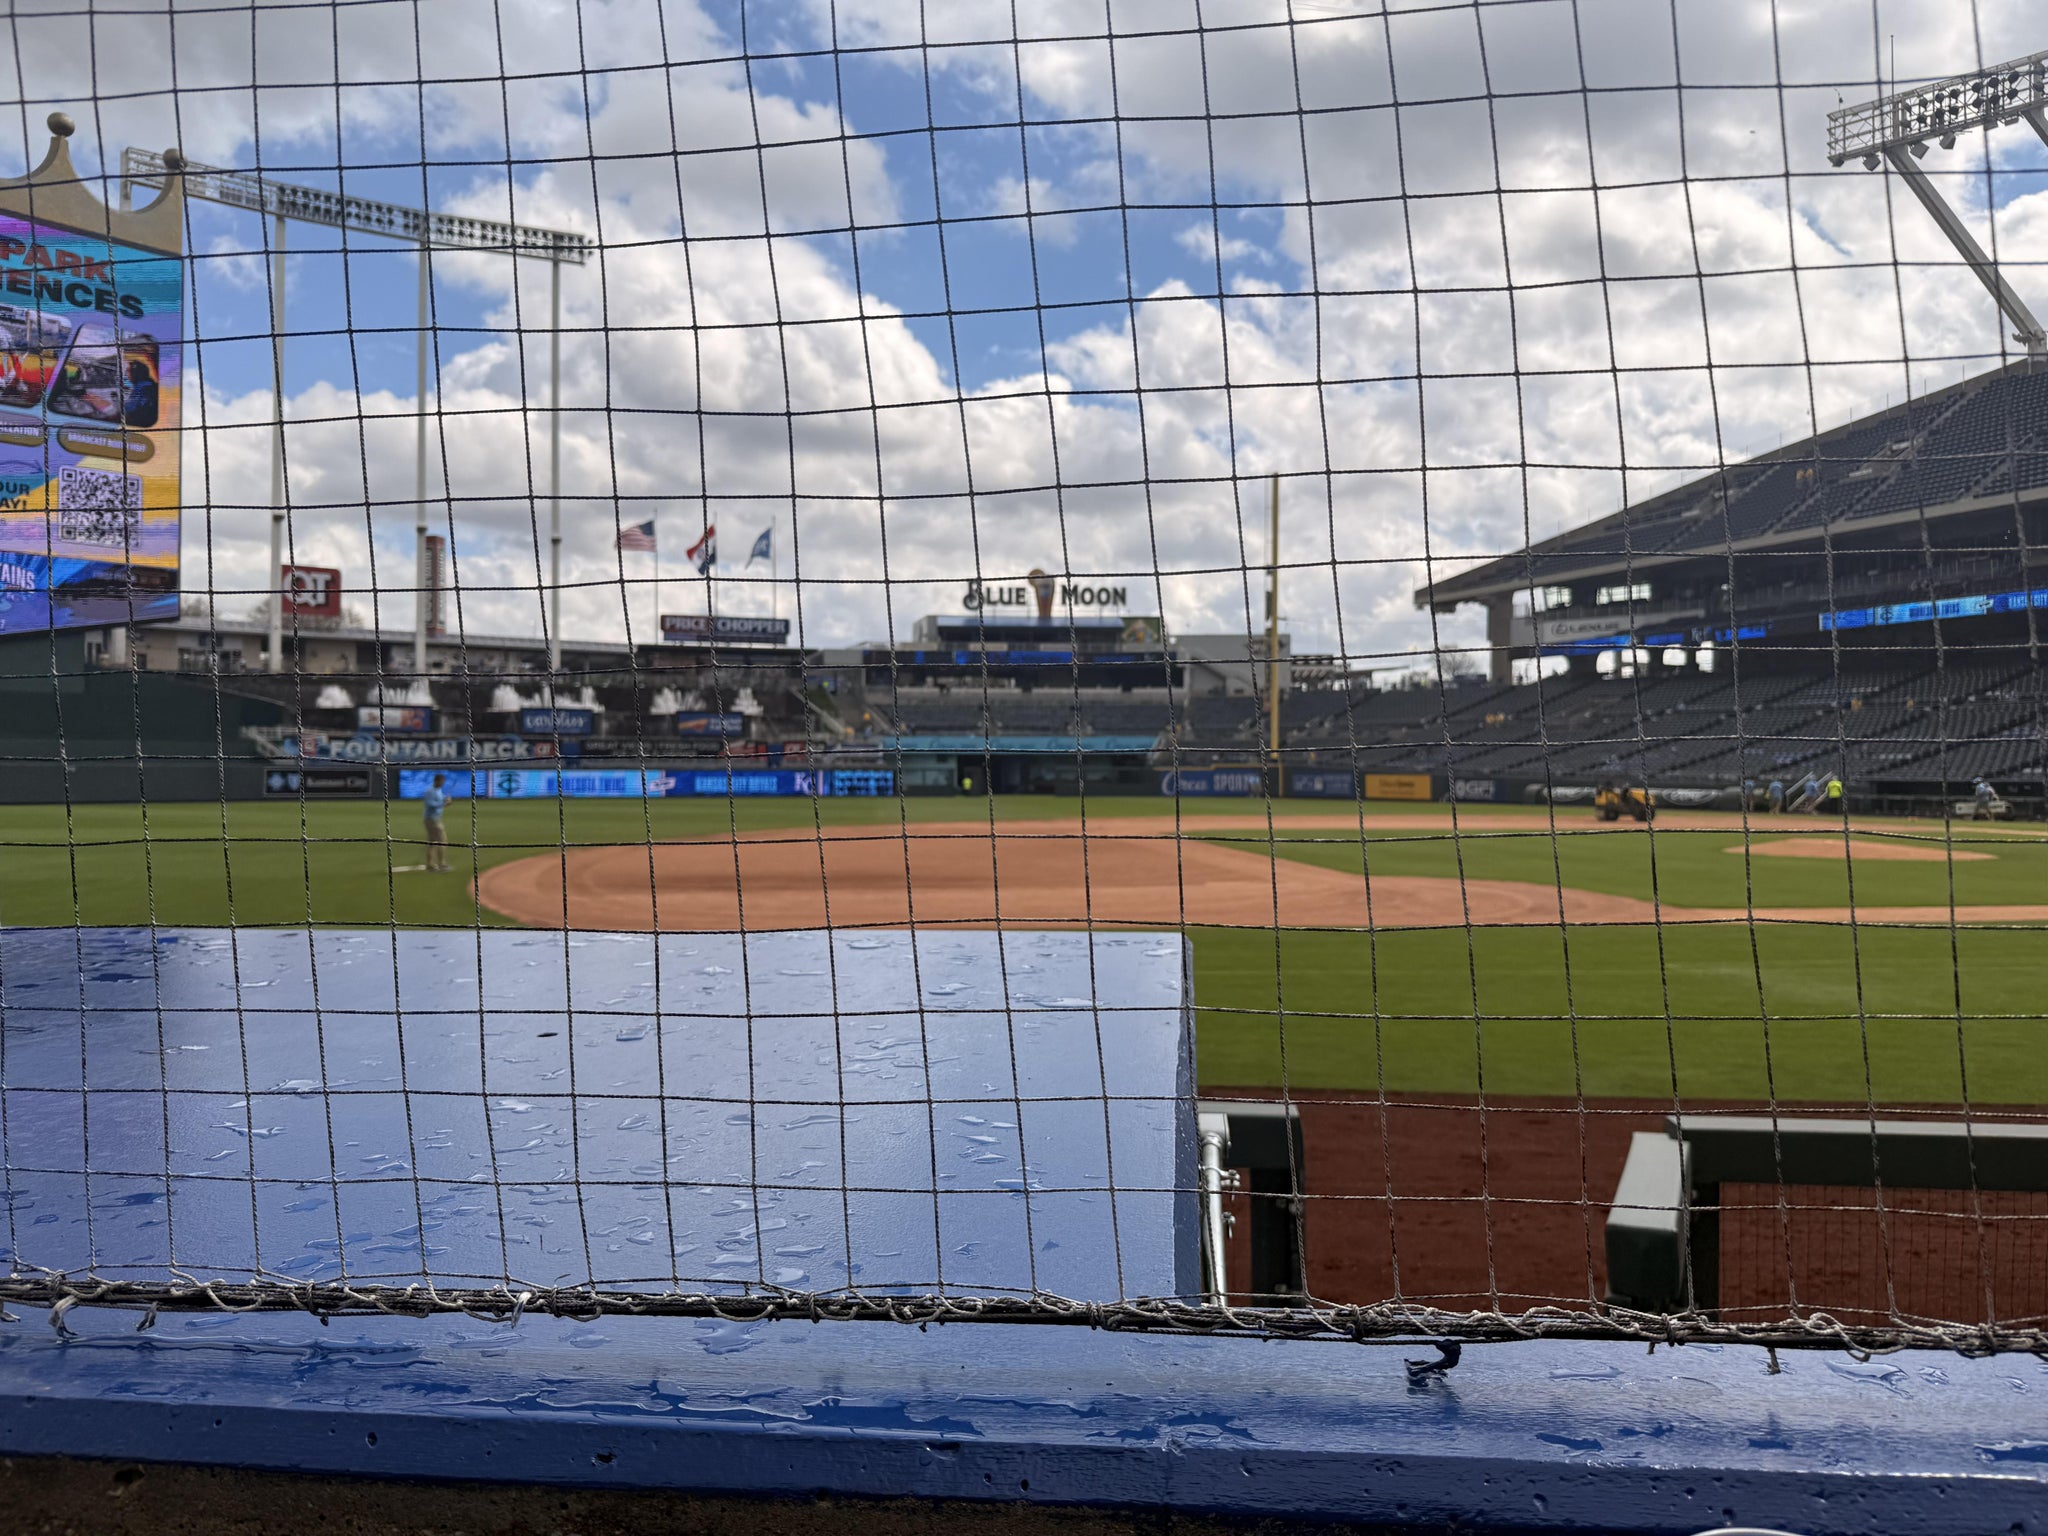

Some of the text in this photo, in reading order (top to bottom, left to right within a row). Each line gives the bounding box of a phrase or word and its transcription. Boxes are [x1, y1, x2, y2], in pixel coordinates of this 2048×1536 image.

[0, 266, 145, 320] ENCES
[0, 562, 36, 594] AINS
[283, 570, 332, 607] QT
[963, 579, 1126, 610] BLUE MOON
[664, 617, 786, 634] PRICE CHOPPER
[329, 741, 529, 759] FOUNTAIN DECK
[1213, 774, 1253, 792] SPORT
